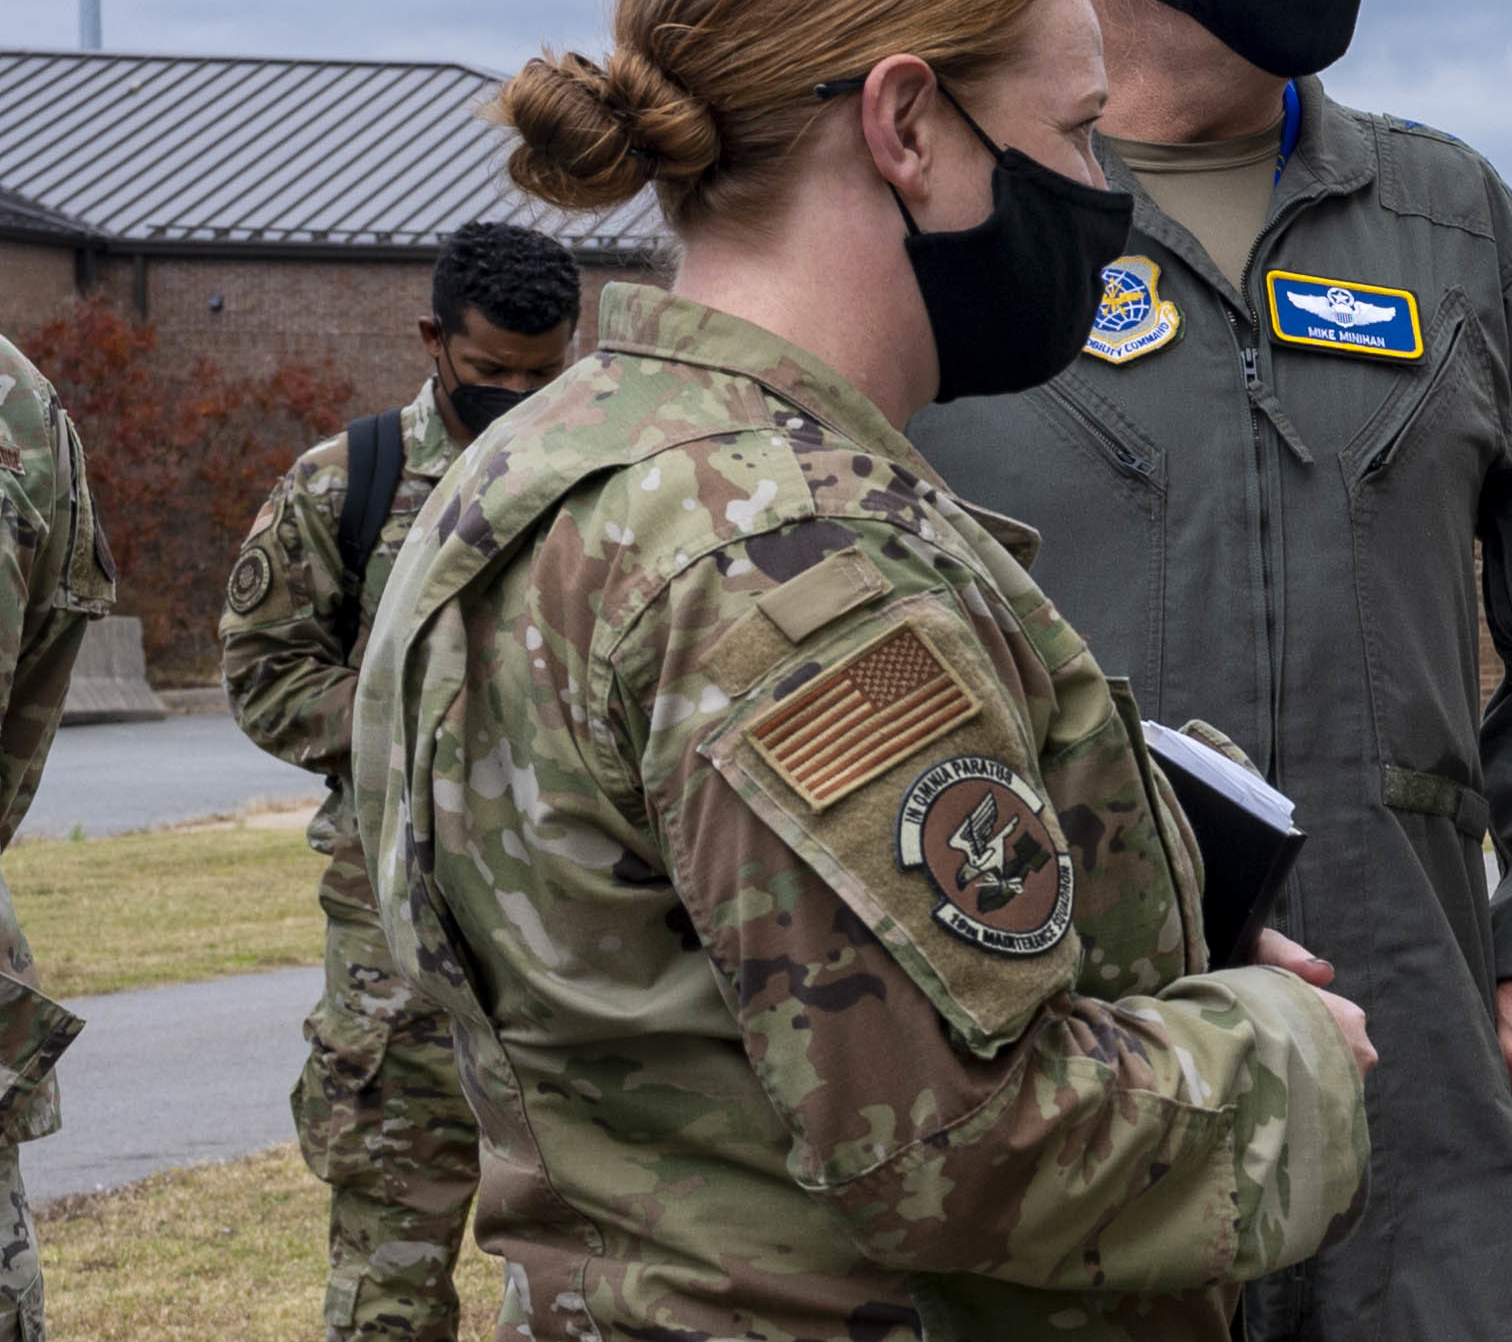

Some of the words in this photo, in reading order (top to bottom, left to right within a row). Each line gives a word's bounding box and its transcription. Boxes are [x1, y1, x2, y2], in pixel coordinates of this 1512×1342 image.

[1087, 339, 1123, 356] OBILITY
[1124, 322, 1170, 353] COMMAND
[1308, 326, 1337, 341] MIKE
[1338, 331, 1386, 348] MINIHAN
[905, 810, 923, 824] IN
[914, 768, 954, 806] OMNIA
[953, 758, 1013, 786] PARATUS
[1053, 865, 1071, 930] SQUADRON
